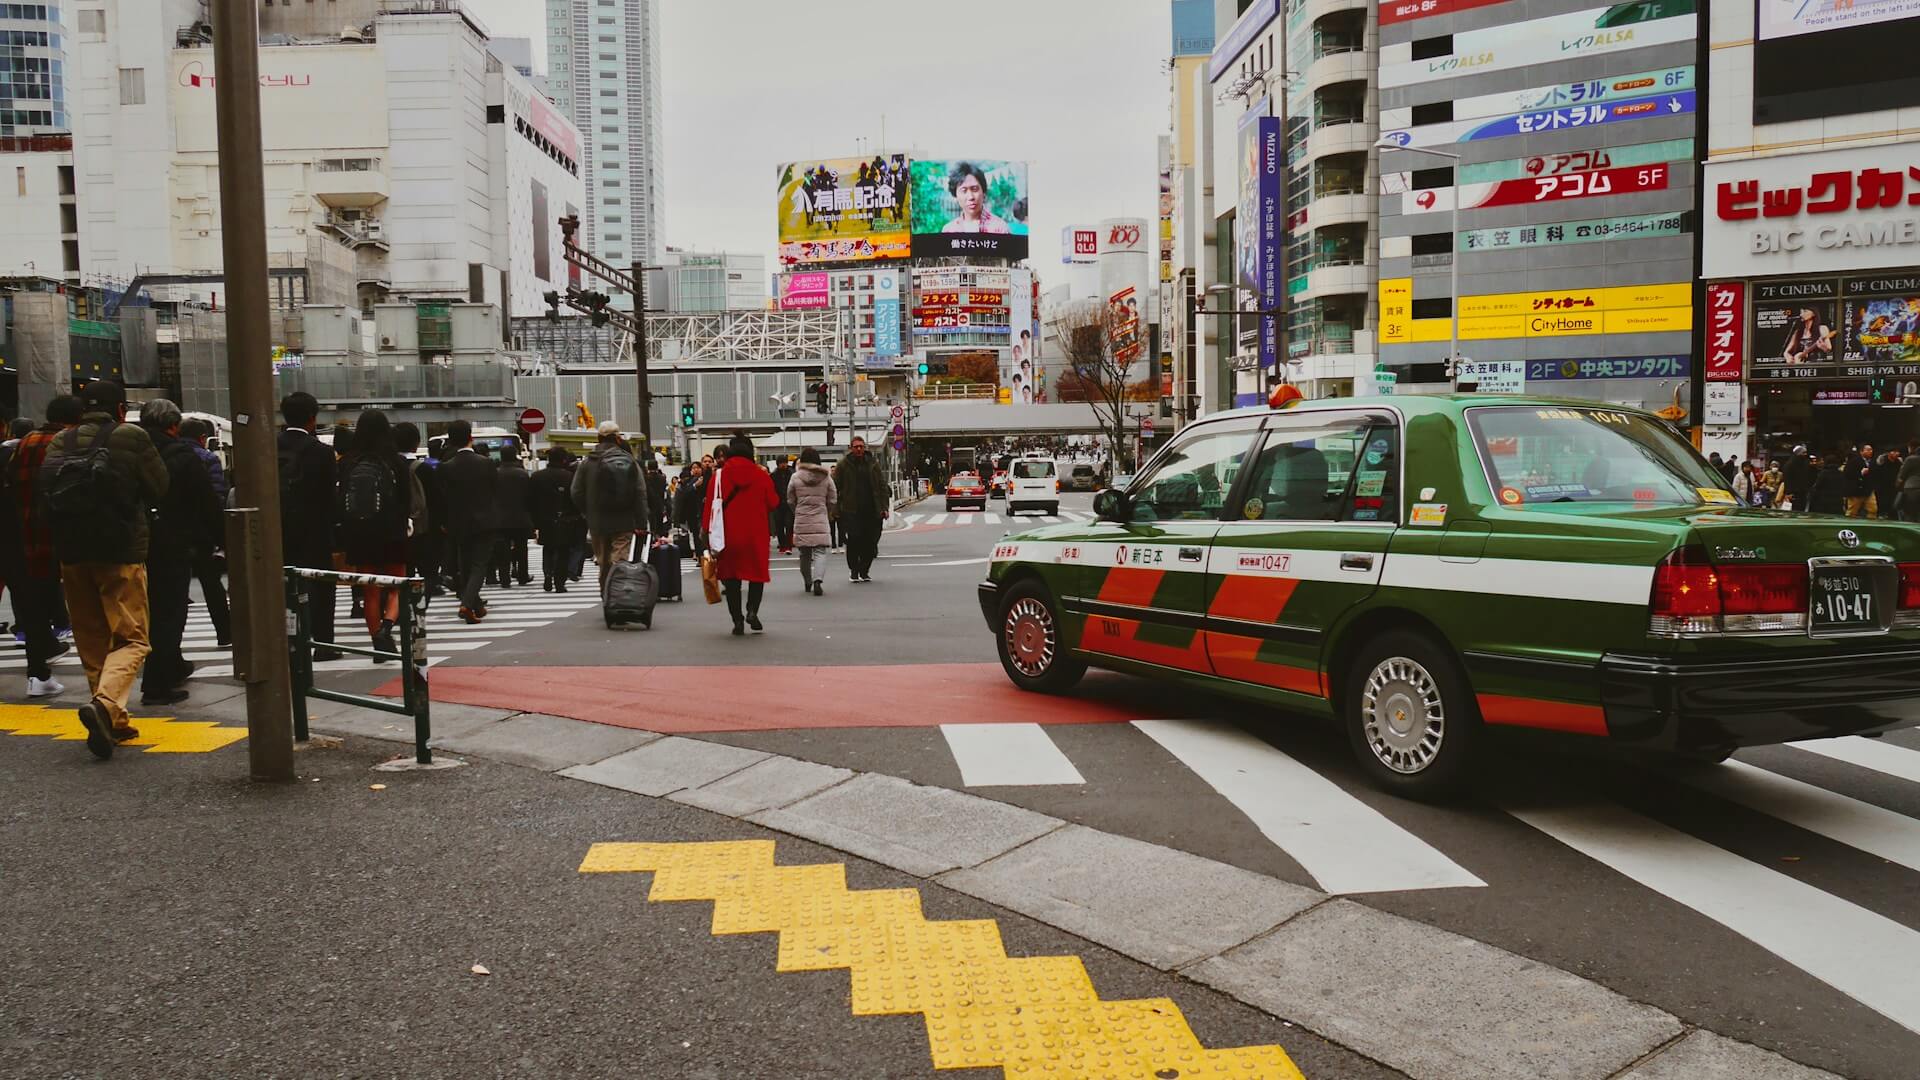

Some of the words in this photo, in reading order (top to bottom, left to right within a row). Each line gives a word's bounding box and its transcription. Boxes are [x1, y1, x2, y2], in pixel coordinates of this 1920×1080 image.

[1421, 0, 1437, 11] 8F
[1639, 3, 1662, 20] 7F
[1805, 16, 1832, 25] People
[1835, 12, 1857, 21] stand
[1873, 7, 1886, 15] the
[1888, 5, 1903, 13] left
[201, 75, 310, 88] TYU
[1664, 71, 1685, 86] 6F
[1516, 105, 1607, 133] セントラル
[1617, 104, 1652, 114] カードローン
[1266, 132, 1275, 174] MIZUHO
[1551, 151, 1611, 174] アコム
[1535, 172, 1612, 200] アコム
[1638, 169, 1663, 185] 5F
[812, 184, 896, 212] 有馬記念
[1717, 166, 1920, 221] ビックカ
[1265, 196, 1275, 240] みずほ証券
[951, 239, 998, 249] 働きたいけど
[1076, 233, 1094, 242] UNI
[1109, 228, 1140, 248] 109
[1468, 226, 1564, 248] 衣笠眼科
[1751, 230, 1804, 255] BIC
[1816, 218, 1920, 249] CAME
[1077, 243, 1095, 252] QLO
[1762, 286, 1776, 296] 7F
[1780, 284, 1832, 296] CINEMA
[1850, 281, 1866, 292] 9F
[969, 294, 1001, 302] コンタクト
[1532, 296, 1595, 310] シティホーム
[945, 307, 963, 315] ガスト
[1386, 306, 1403, 315] 賃貸
[878, 303, 889, 350] アイシティ
[935, 317, 957, 326] ガスト
[1531, 318, 1592, 332] CityHome
[1712, 290, 1735, 367] カラオケ
[1388, 324, 1402, 335] 3F
[1465, 363, 1511, 374] 衣笠眼科
[1532, 363, 1556, 378] 2F
[1580, 358, 1683, 377] 中央コンタクト
[1794, 368, 1817, 377] TOEI
[1378, 385, 1393, 394] 1047
[1589, 411, 1630, 425] 1047
[1132, 548, 1164, 564] 新日本
[1262, 555, 1289, 570] 1047
[1816, 601, 1825, 615] あ
[1827, 594, 1871, 622] 10-47
[1102, 619, 1120, 637] TAXI
